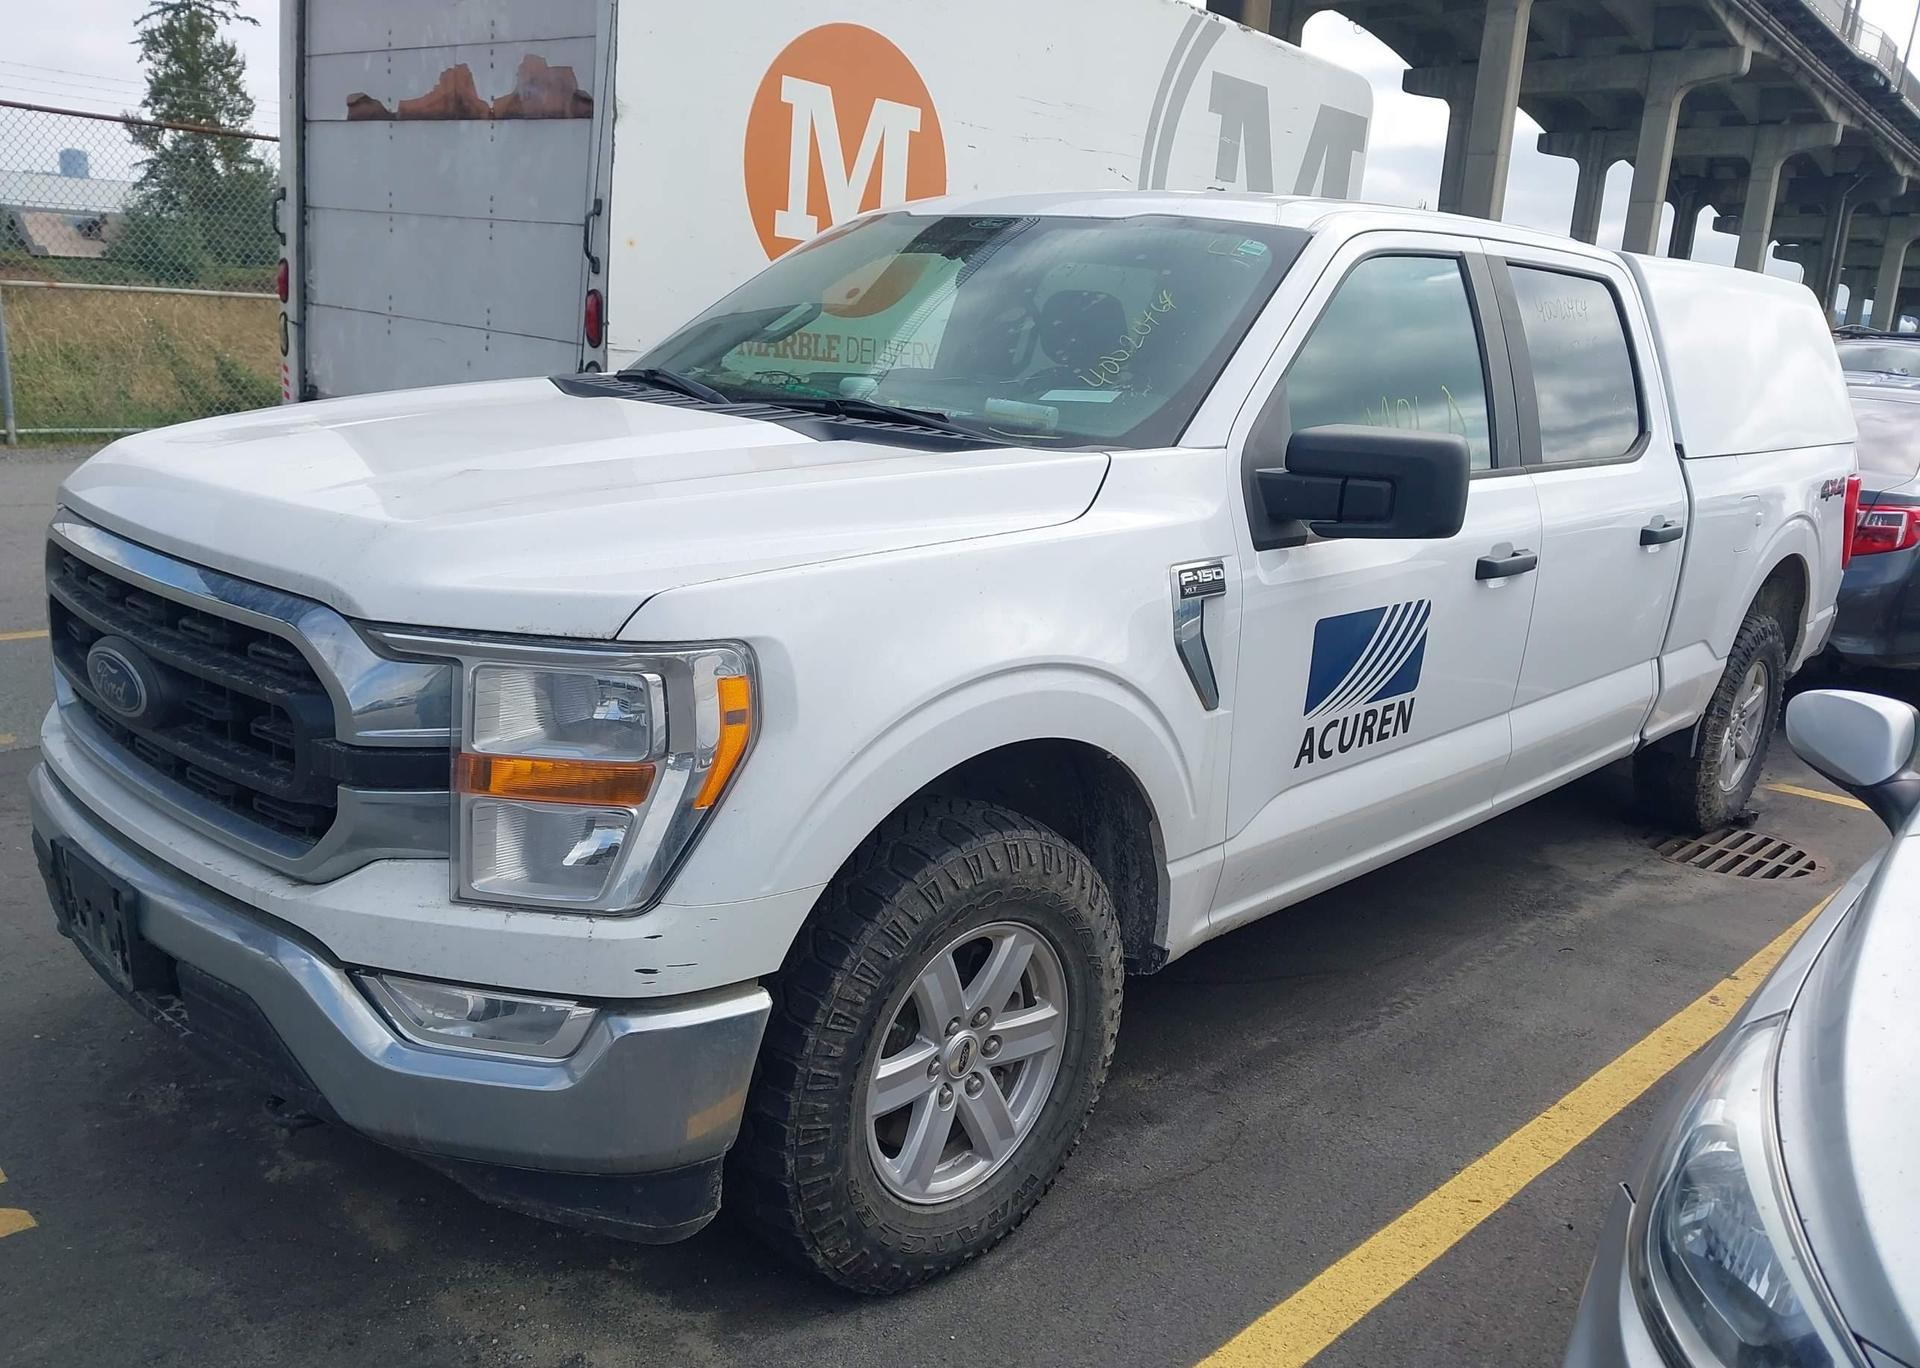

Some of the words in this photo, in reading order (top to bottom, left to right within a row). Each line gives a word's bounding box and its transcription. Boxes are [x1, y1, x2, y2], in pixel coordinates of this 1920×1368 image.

[774, 75, 921, 241] M
[735, 331, 841, 363] MARBLE
[1180, 568, 1224, 586] F-150
[1293, 697, 1415, 769] ACUREN
